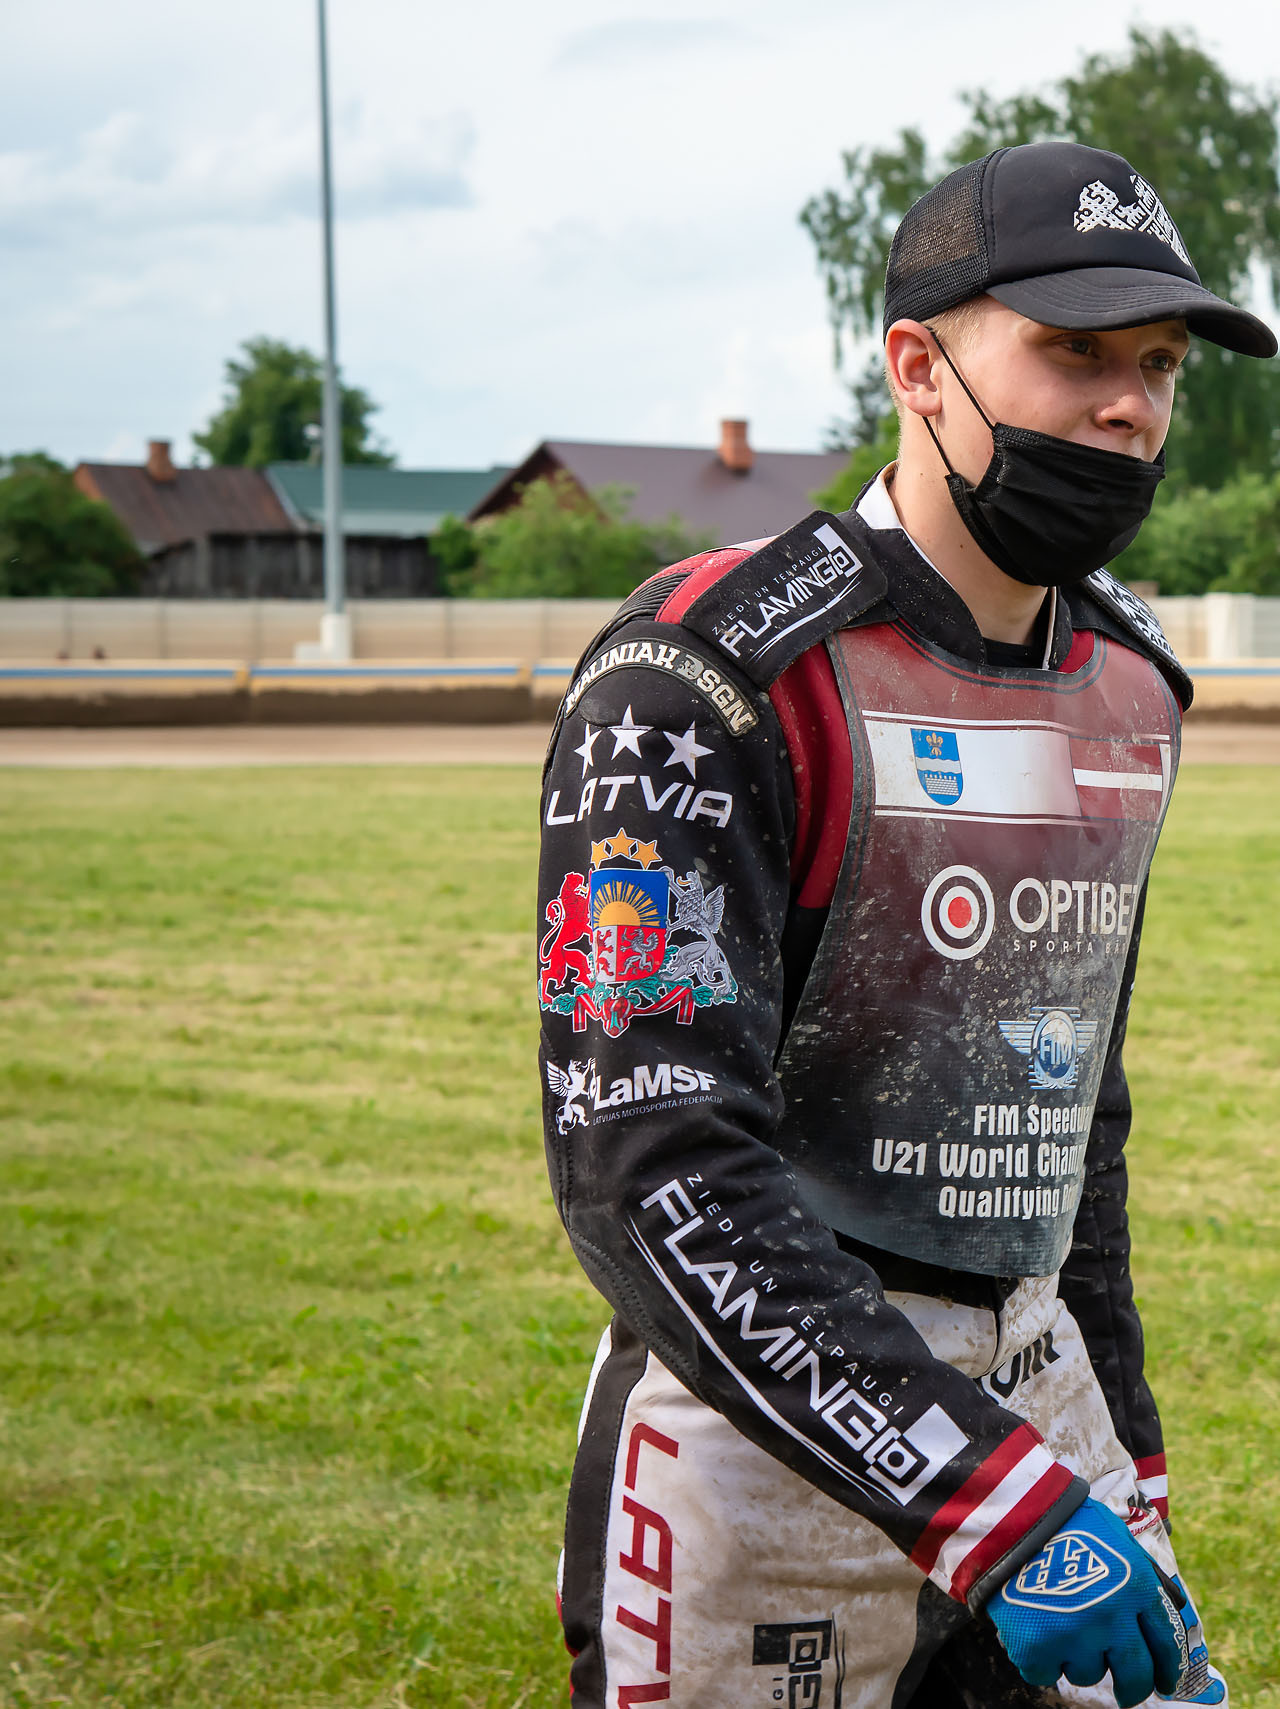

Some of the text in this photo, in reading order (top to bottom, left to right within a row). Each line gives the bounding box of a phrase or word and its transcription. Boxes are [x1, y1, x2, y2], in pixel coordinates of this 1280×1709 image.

[711, 599, 751, 636] ZIEDI
[755, 585, 769, 598] UN
[565, 643, 681, 714] MALINIAK
[545, 775, 733, 828] LATVIA
[1013, 940, 1094, 954] SPORTA
[1040, 1033, 1073, 1065] FIM
[594, 1063, 718, 1111] LaMSF
[592, 1110, 621, 1126] LATVIJAS
[621, 1099, 678, 1119] MOTOSPORTA
[973, 1104, 1019, 1136] FIM
[873, 1139, 926, 1176] U21
[938, 1143, 1029, 1179] World
[938, 1185, 1060, 1221] Qualifying
[687, 1173, 743, 1246] ZIEDI
[749, 1260, 777, 1293] UN
